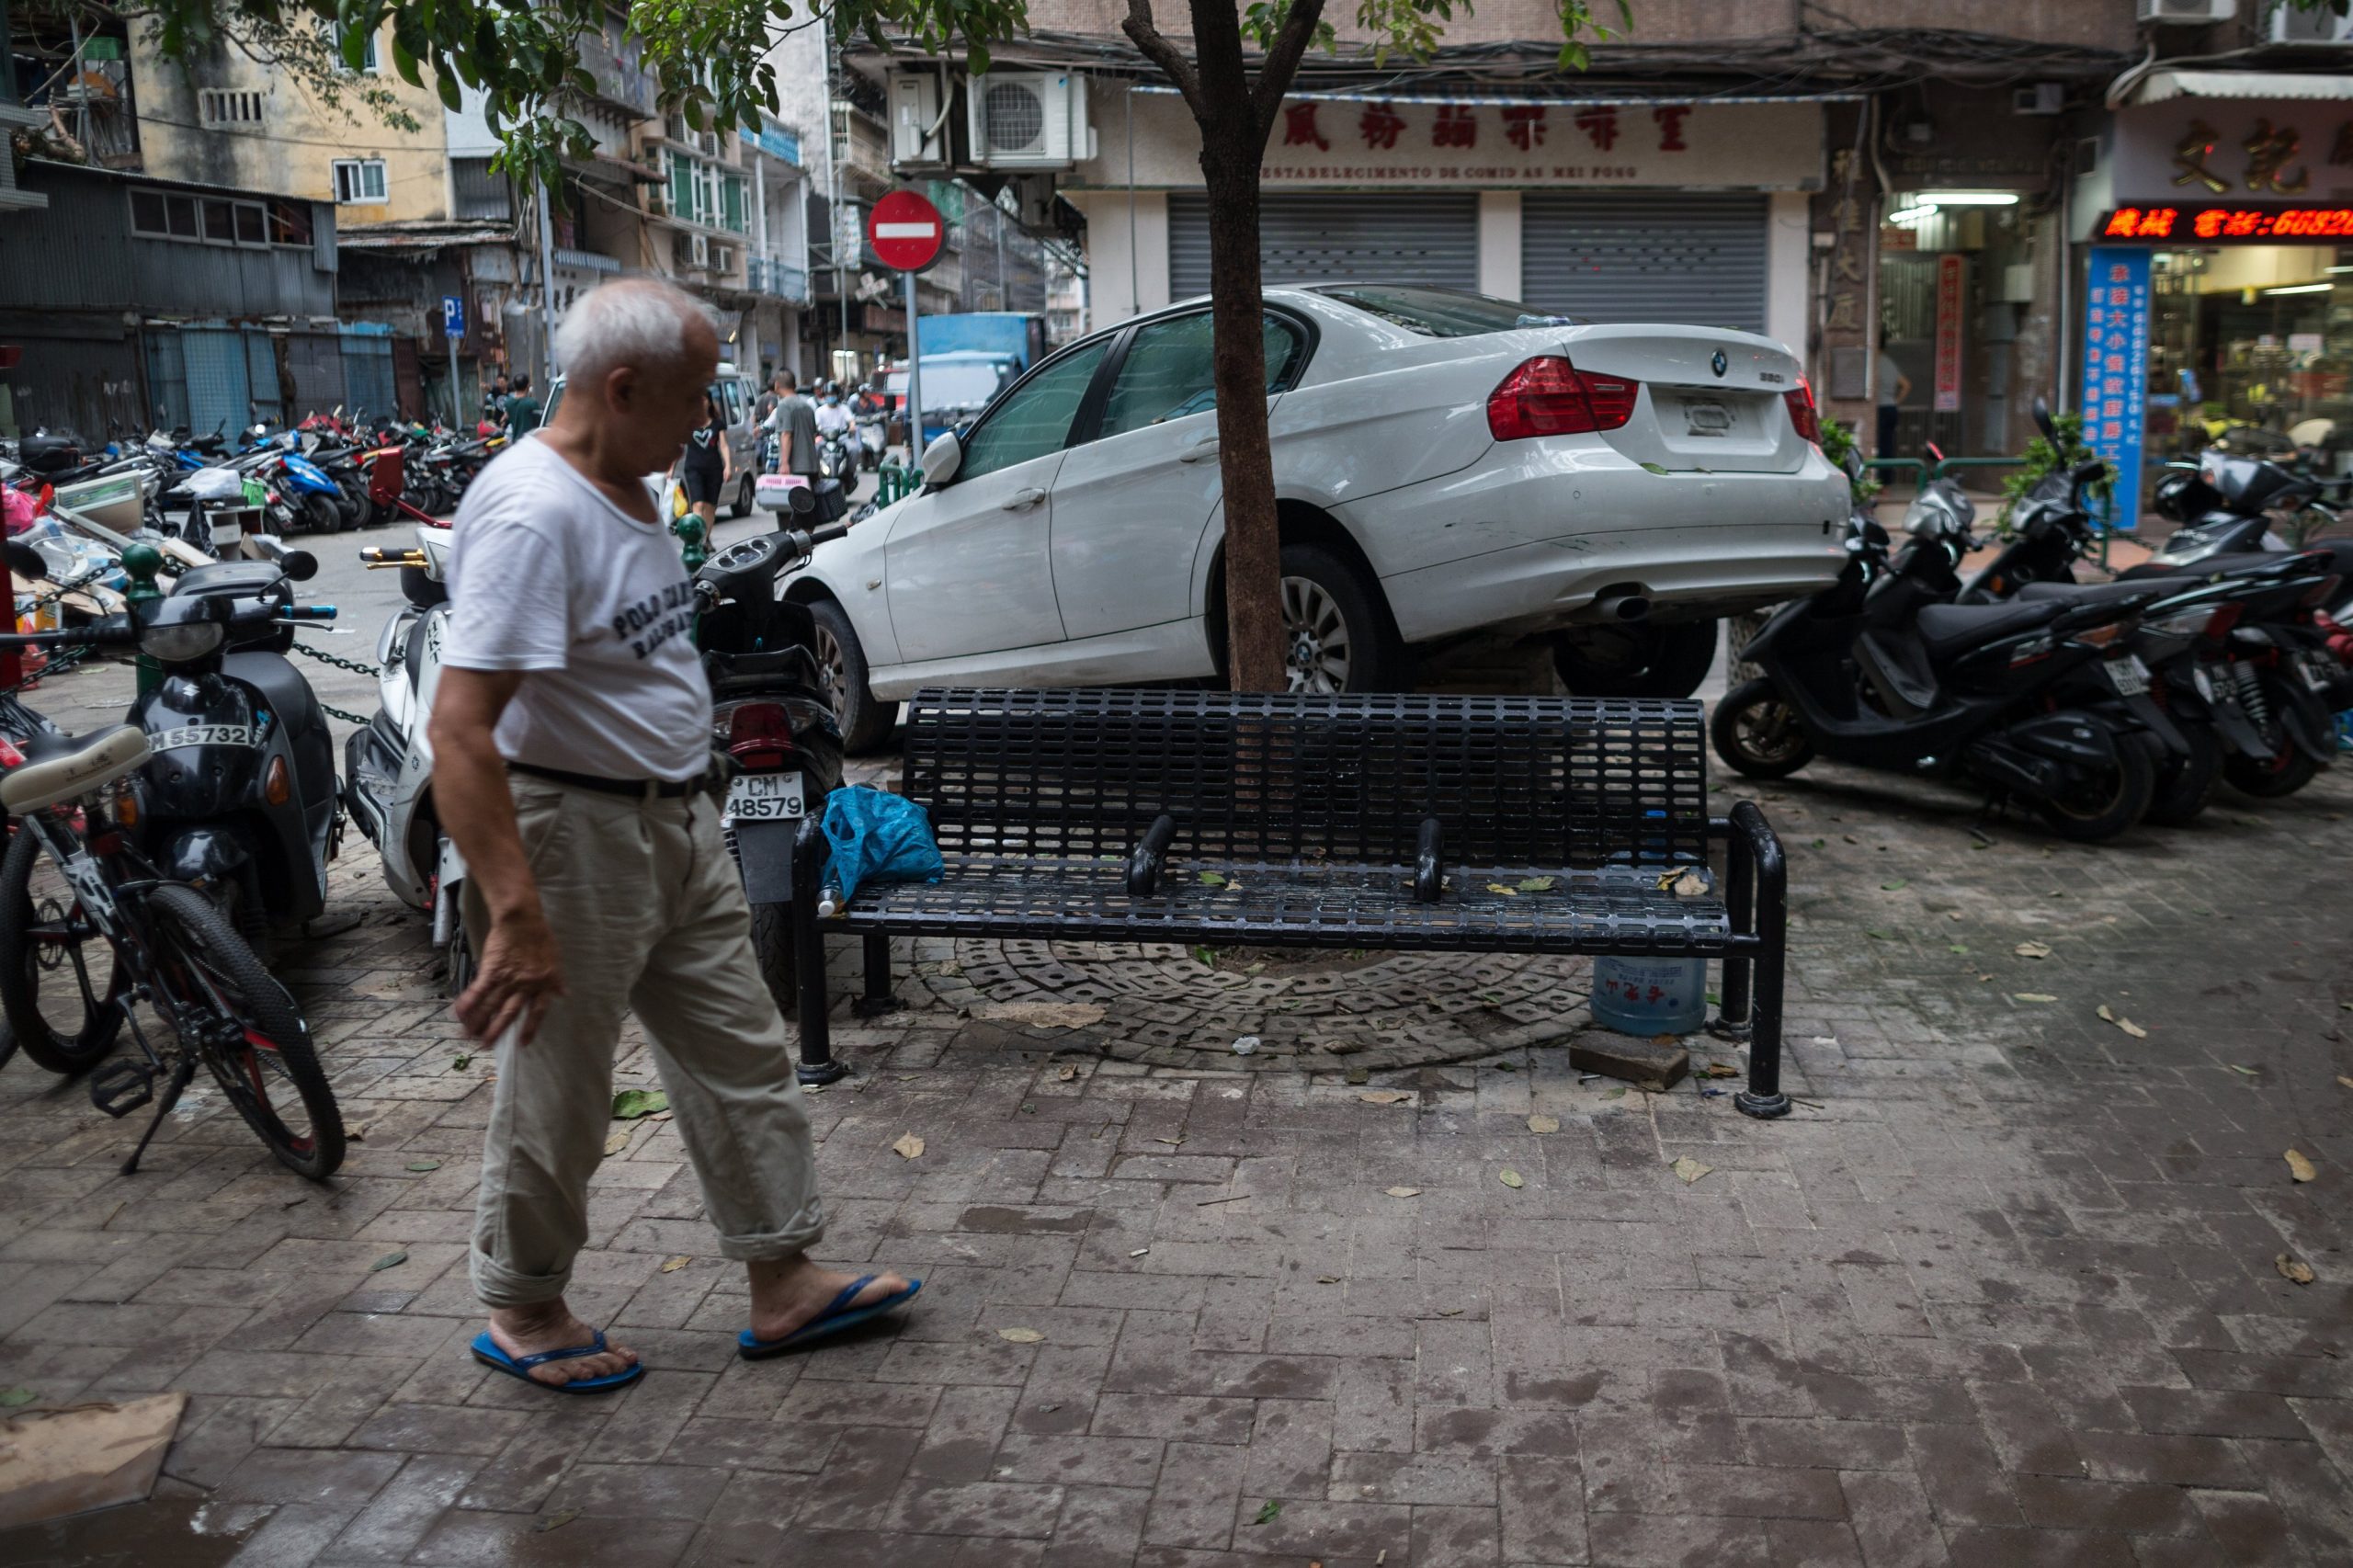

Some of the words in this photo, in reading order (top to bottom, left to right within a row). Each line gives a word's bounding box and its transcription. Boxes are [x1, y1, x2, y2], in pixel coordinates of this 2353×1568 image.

[1438, 167, 1459, 178] DE
[1552, 166, 1584, 177] MEI
[444, 299, 456, 326] P
[147, 733, 165, 751] M
[169, 727, 246, 745] 55732
[747, 776, 779, 797] CM
[726, 796, 801, 817] 48579
